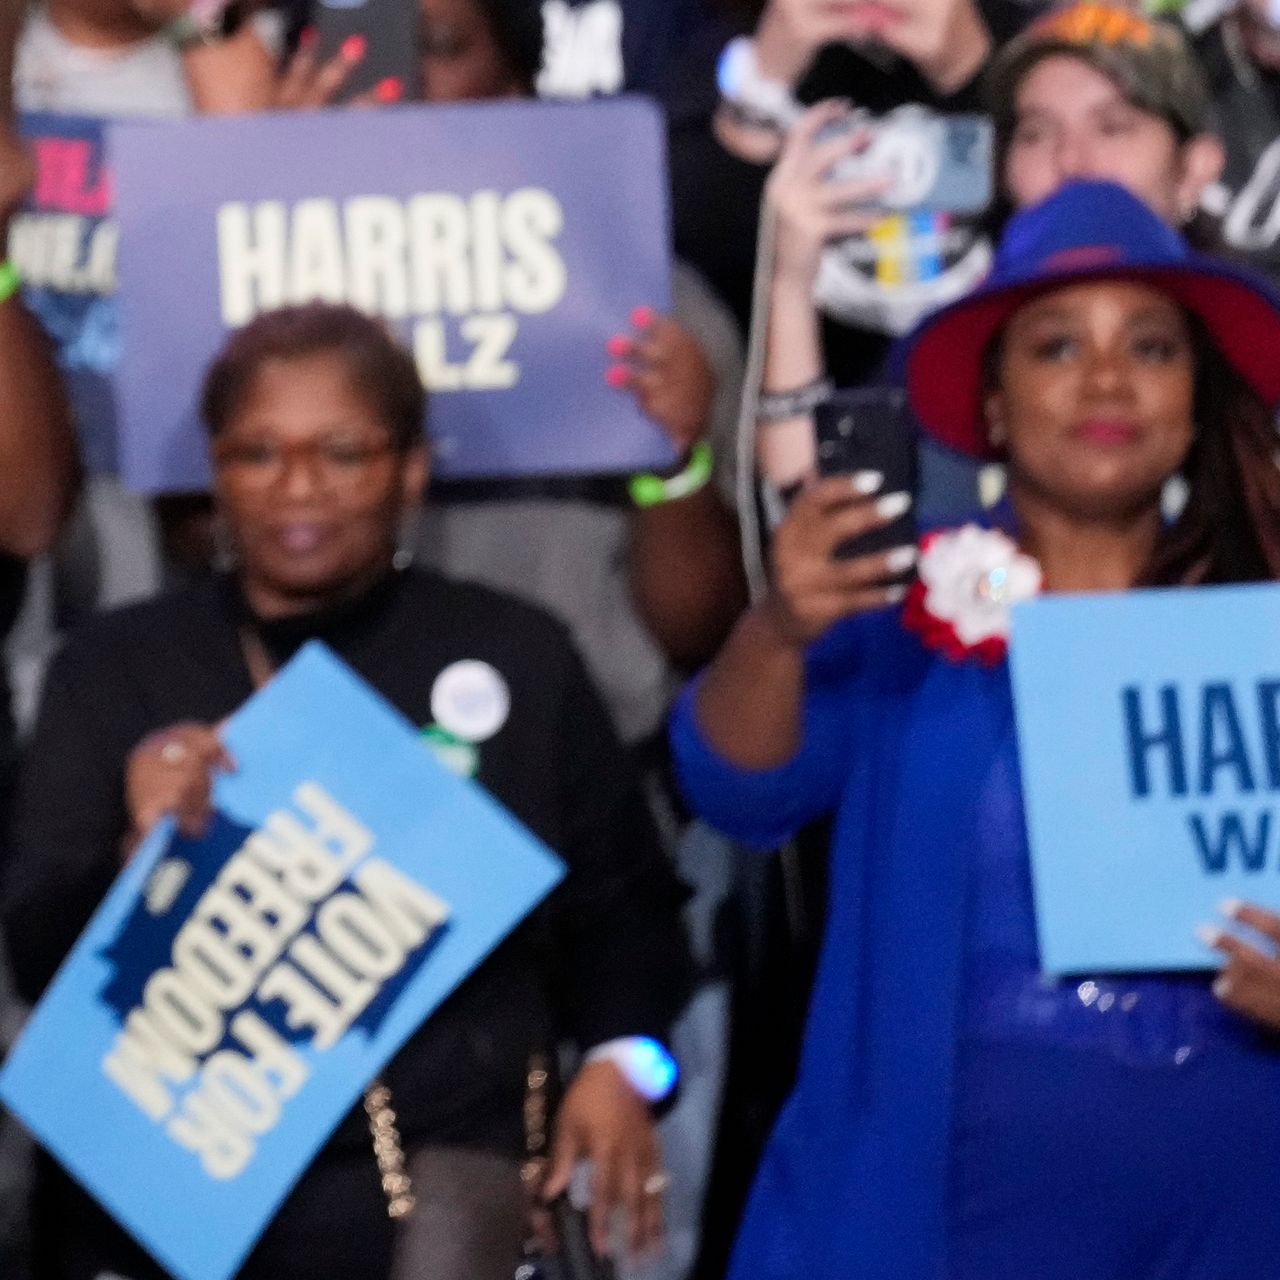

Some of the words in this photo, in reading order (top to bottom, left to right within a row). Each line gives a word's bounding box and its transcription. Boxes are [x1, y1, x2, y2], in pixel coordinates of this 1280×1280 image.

[217, 186, 567, 328] HARRIS
[412, 314, 520, 392] LZ
[102, 778, 376, 1122] FREEDOM
[255, 855, 452, 1052] VOTE
[165, 1008, 312, 1182] FOR
